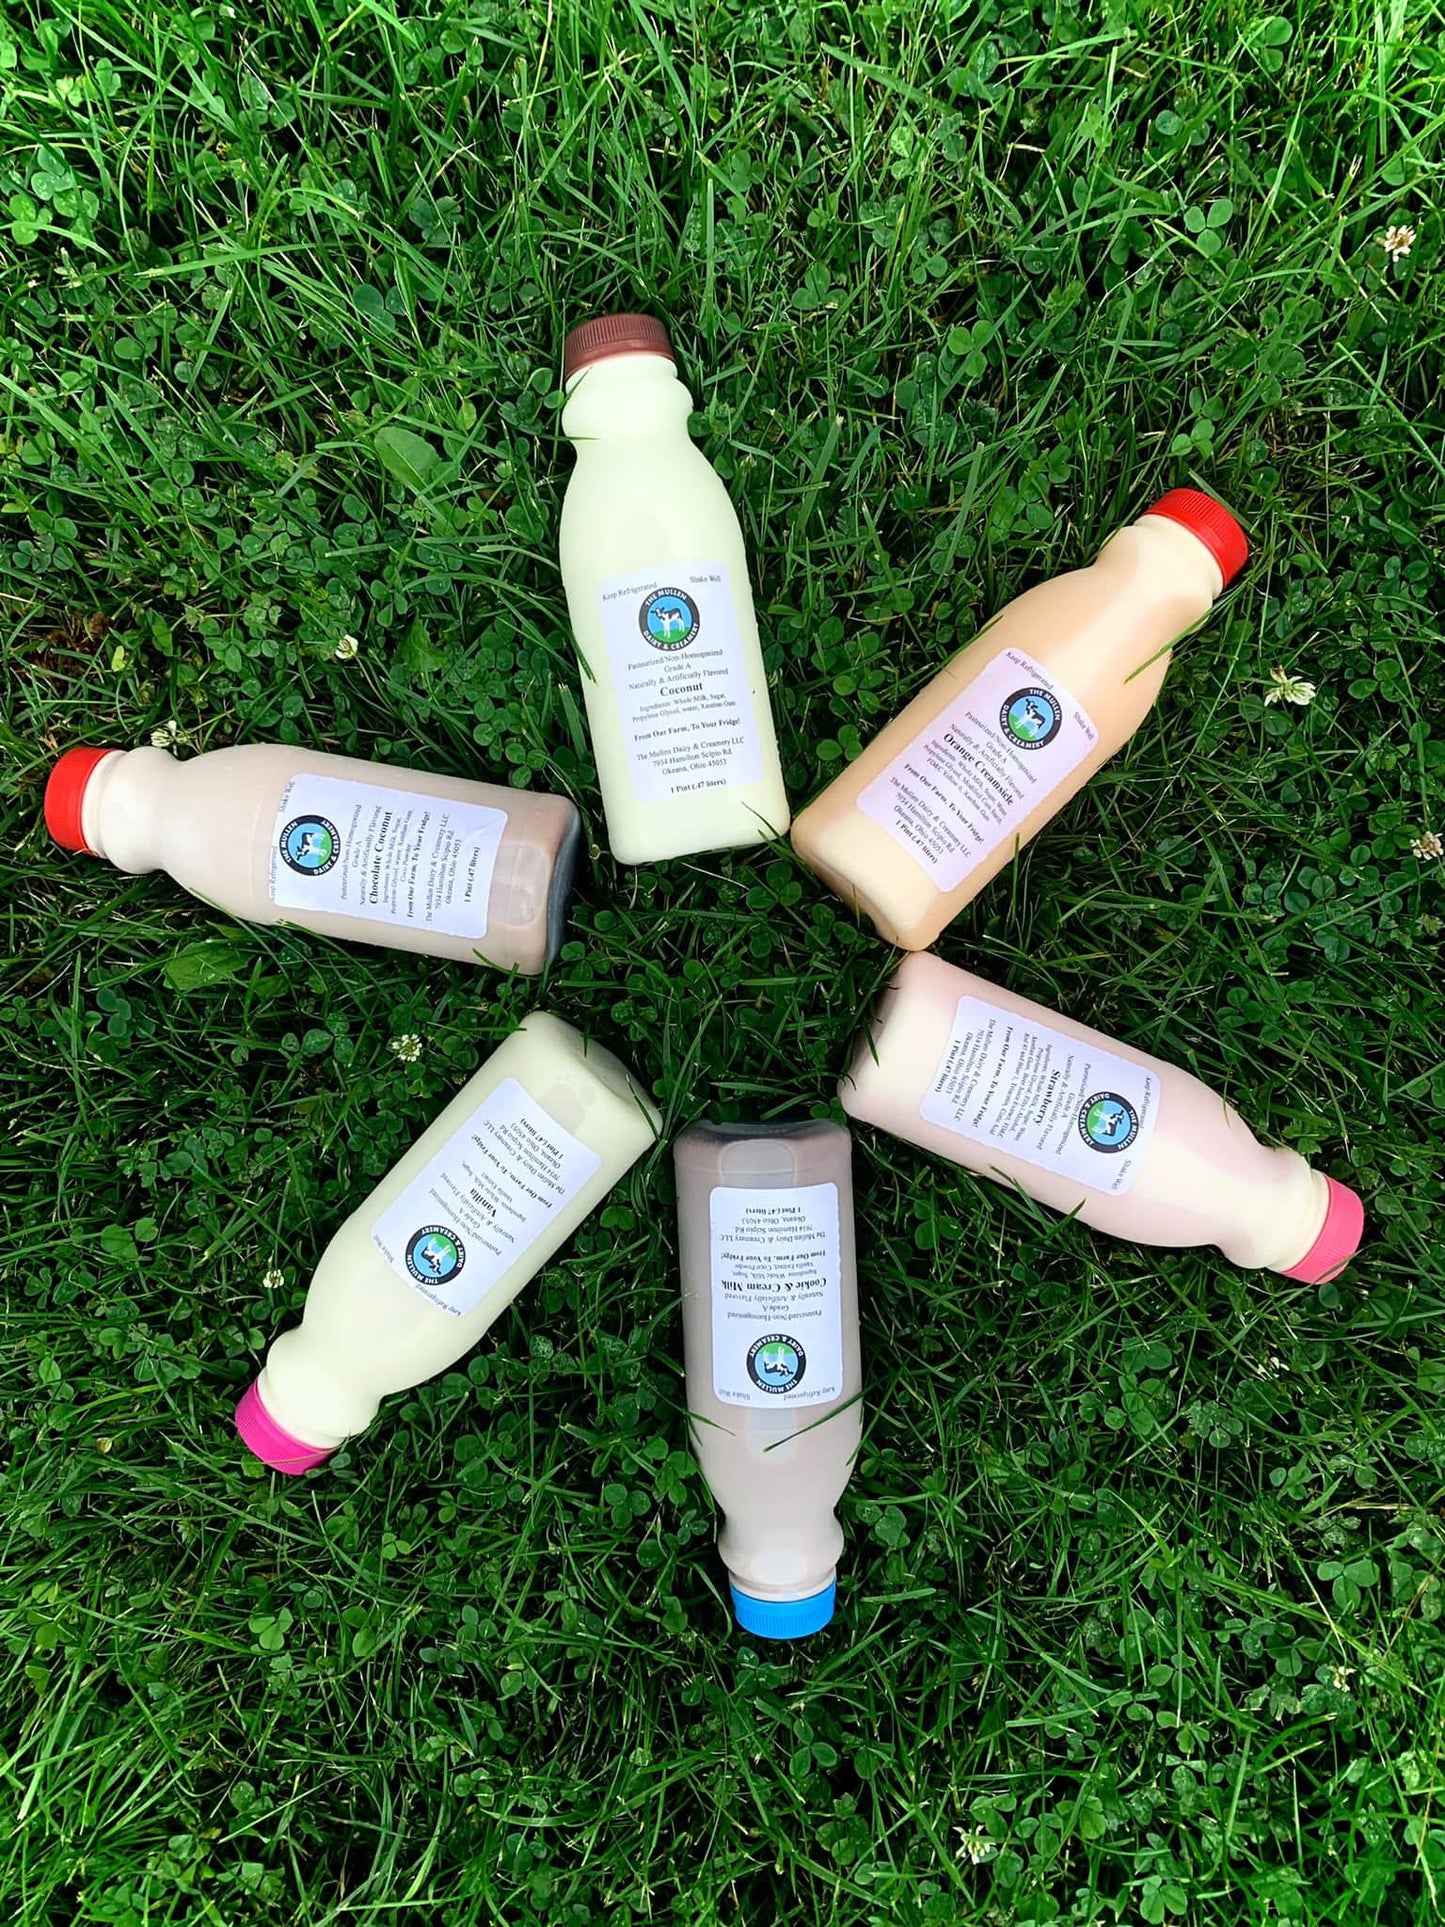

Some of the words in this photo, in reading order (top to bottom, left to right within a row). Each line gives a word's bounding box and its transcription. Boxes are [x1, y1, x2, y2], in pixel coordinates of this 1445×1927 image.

[643, 592, 659, 608] THE
[657, 588, 689, 602] MULLEN
[643, 629, 663, 649] DAIRY
[670, 621, 699, 650] CREAMERY
[660, 682, 703, 696] Coconut
[1029, 688, 1046, 698] THE
[1044, 692, 1062, 721] MULLEN
[1001, 702, 1012, 727] DAIRY
[1007, 731, 1045, 747] CREAMERY
[943, 733, 974, 762] Orange
[969, 760, 1013, 805] Creamsicle
[919, 775, 932, 787] Our
[280, 820, 298, 848] MULLEN
[319, 818, 339, 853] CREAMERY
[374, 811, 392, 852] Coconut
[281, 849, 293, 865] THE
[312, 857, 334, 874] DAIRY
[369, 855, 382, 904] Chocolate
[1001, 1043, 1009, 1057] Our
[1033, 1069, 1060, 1126] Strawberry
[1088, 1093, 1110, 1106] DAIRY
[1080, 1108, 1097, 1147] CREAMERY
[1127, 1109, 1137, 1126] THE
[1116, 1126, 1137, 1152] MULLEN
[470, 1188, 496, 1218] Vanilla
[525, 1188, 537, 1198] Our
[419, 1226, 455, 1241] CREAMERY
[454, 1244, 463, 1269] DAIRY
[406, 1253, 425, 1281] MULLEN
[423, 1276, 439, 1285] THE
[721, 1280, 742, 1292] Milk
[746, 1283, 781, 1292] Cream
[785, 1283, 793, 1292] &
[795, 1277, 826, 1290] Cookie
[748, 1335, 779, 1358] CREAMERY
[785, 1337, 804, 1357] DAIRY
[754, 1378, 784, 1393] MULLEN
[783, 1377, 799, 1391] THE
